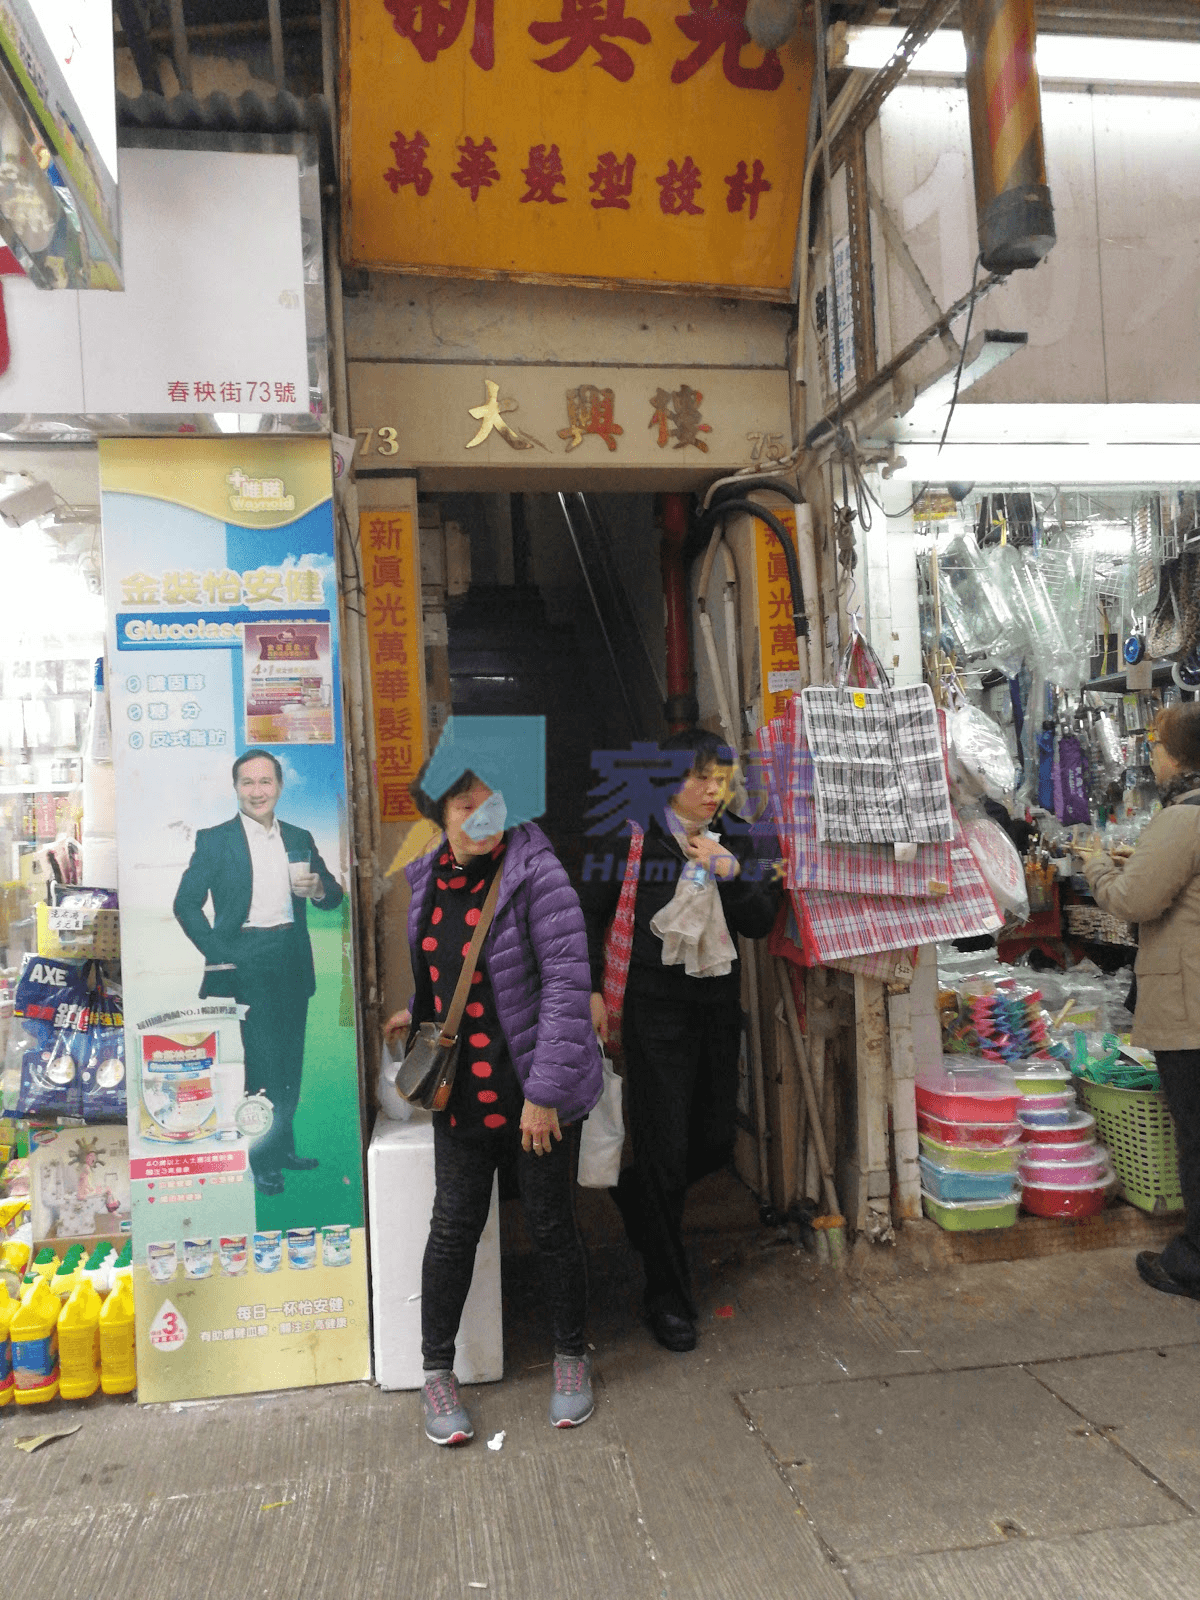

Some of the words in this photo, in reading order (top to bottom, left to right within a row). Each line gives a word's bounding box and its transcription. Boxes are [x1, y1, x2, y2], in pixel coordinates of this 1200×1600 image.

[383, 130, 772, 221] 萬華髮型設計
[167, 380, 297, 404] 春秧街73號
[354, 426, 399, 456] 73
[465, 379, 713, 454] 大興樓
[746, 431, 786, 462] 75
[120, 569, 323, 606] 金裝怡安健
[29, 963, 68, 987] AXE
[162, 1312, 178, 1335] 3
